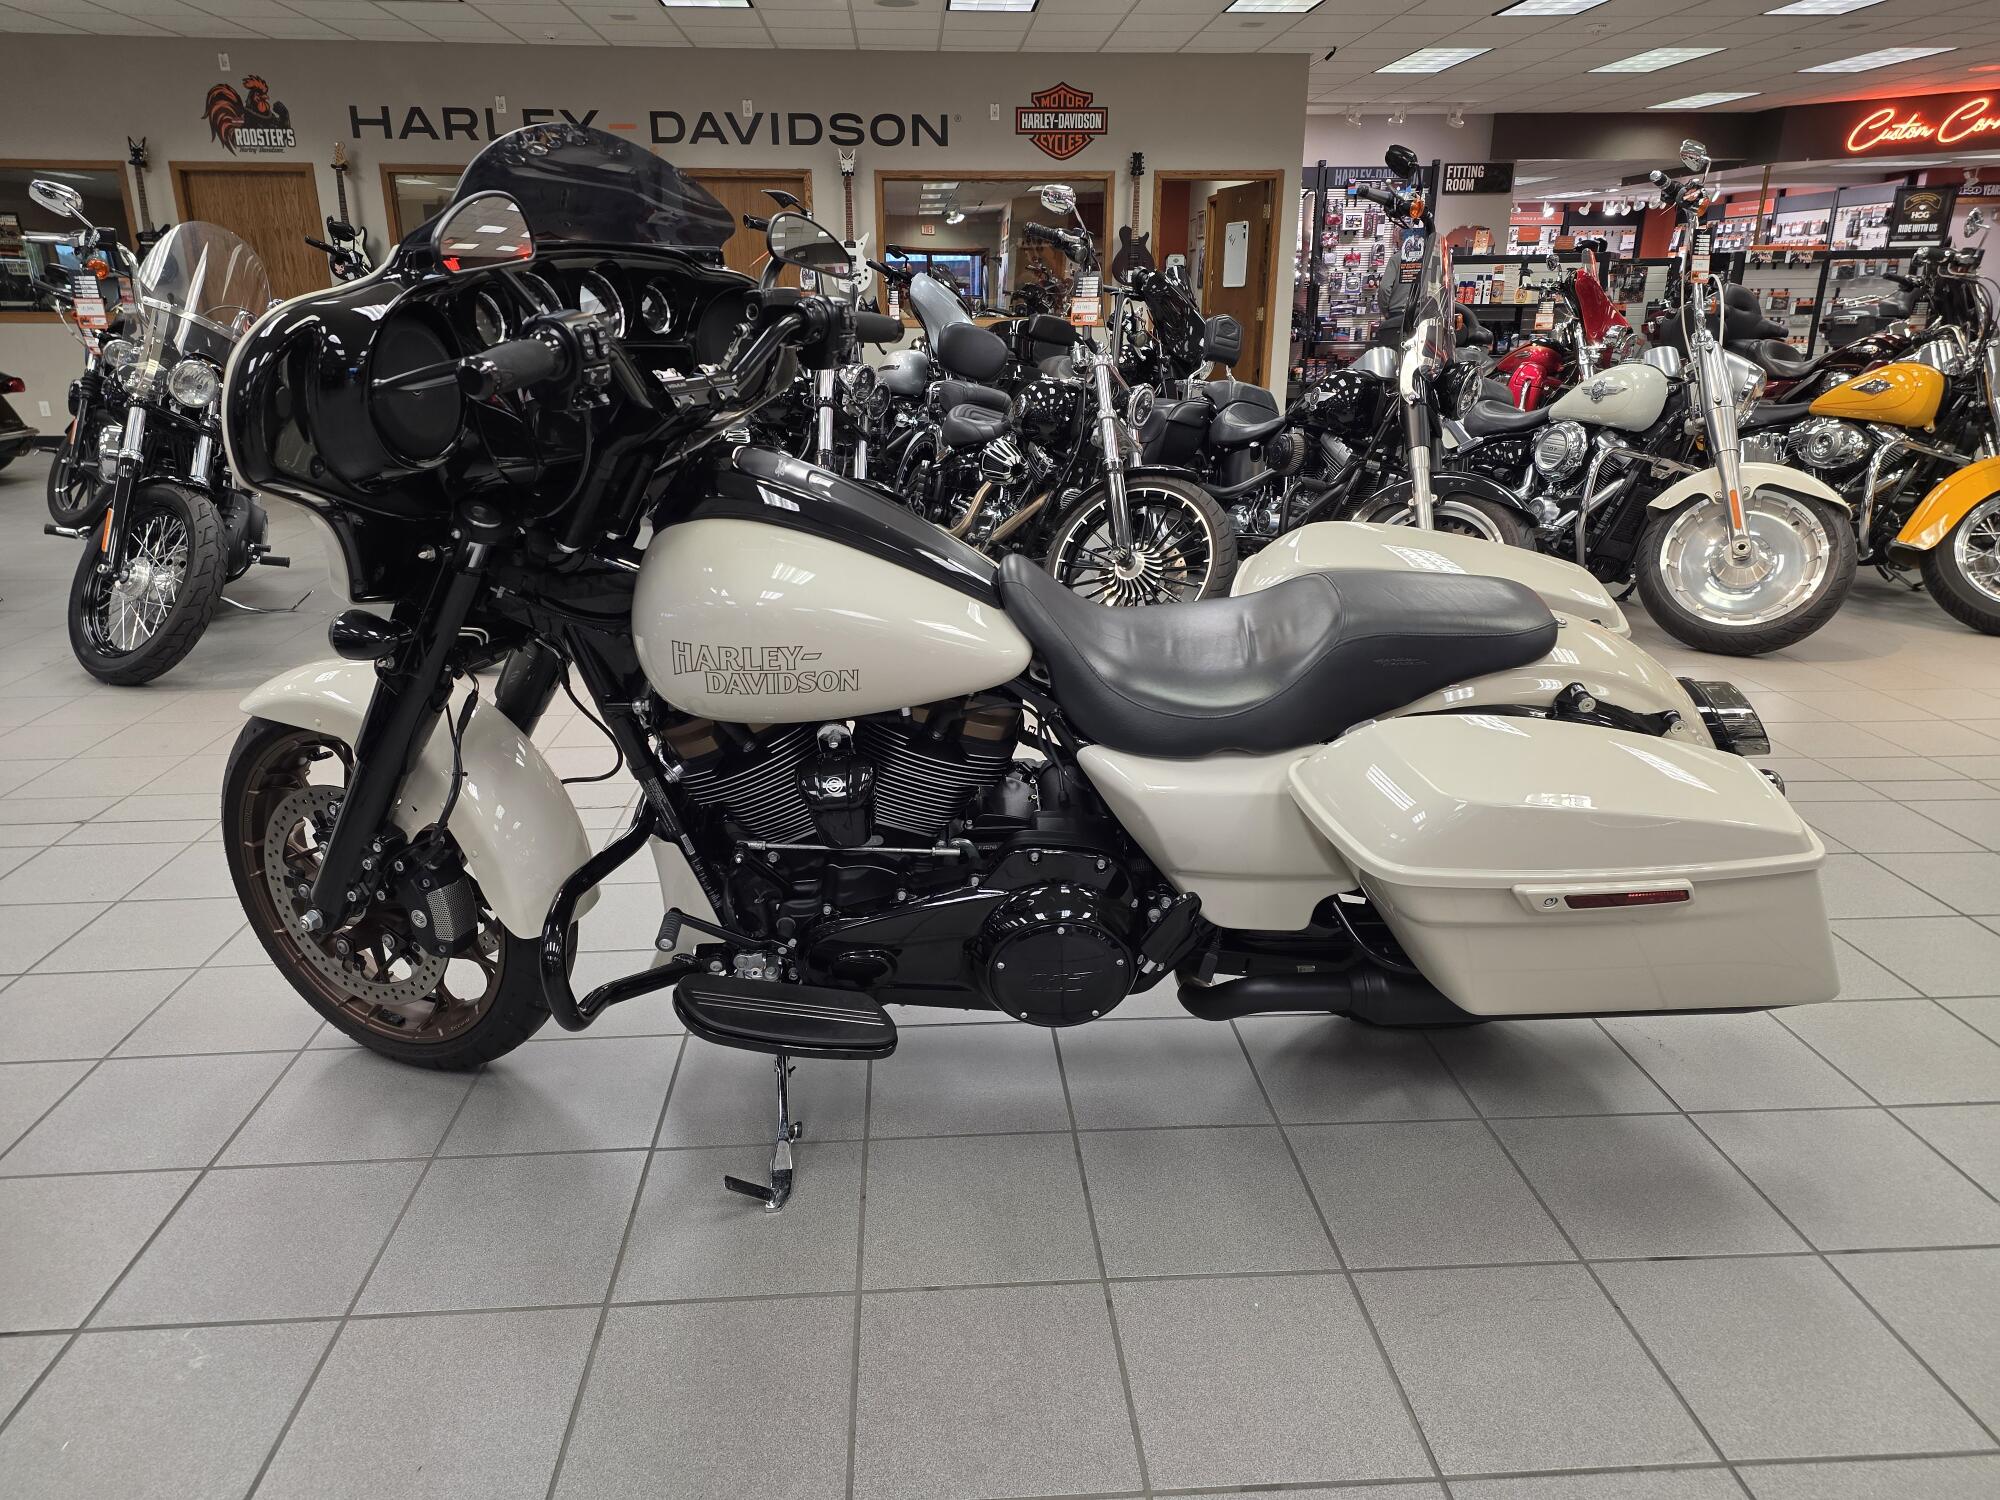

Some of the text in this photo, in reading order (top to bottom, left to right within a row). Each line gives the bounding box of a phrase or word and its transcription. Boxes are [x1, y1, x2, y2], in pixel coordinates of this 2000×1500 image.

[1041, 90, 1084, 108] MOTOR
[1021, 113, 1102, 129] HARLEY-DAVIDSON
[1848, 108, 1936, 151] Custom
[235, 128, 296, 147] ROOSTER'S
[1040, 134, 1083, 155] CYCLES
[1446, 165, 1485, 178] FITTING
[1445, 179, 1475, 191] ROOM
[1898, 224, 1938, 233] RIDE WITH US
[671, 640, 822, 675] HARLEY-
[705, 669, 860, 695] DAVIDSON
